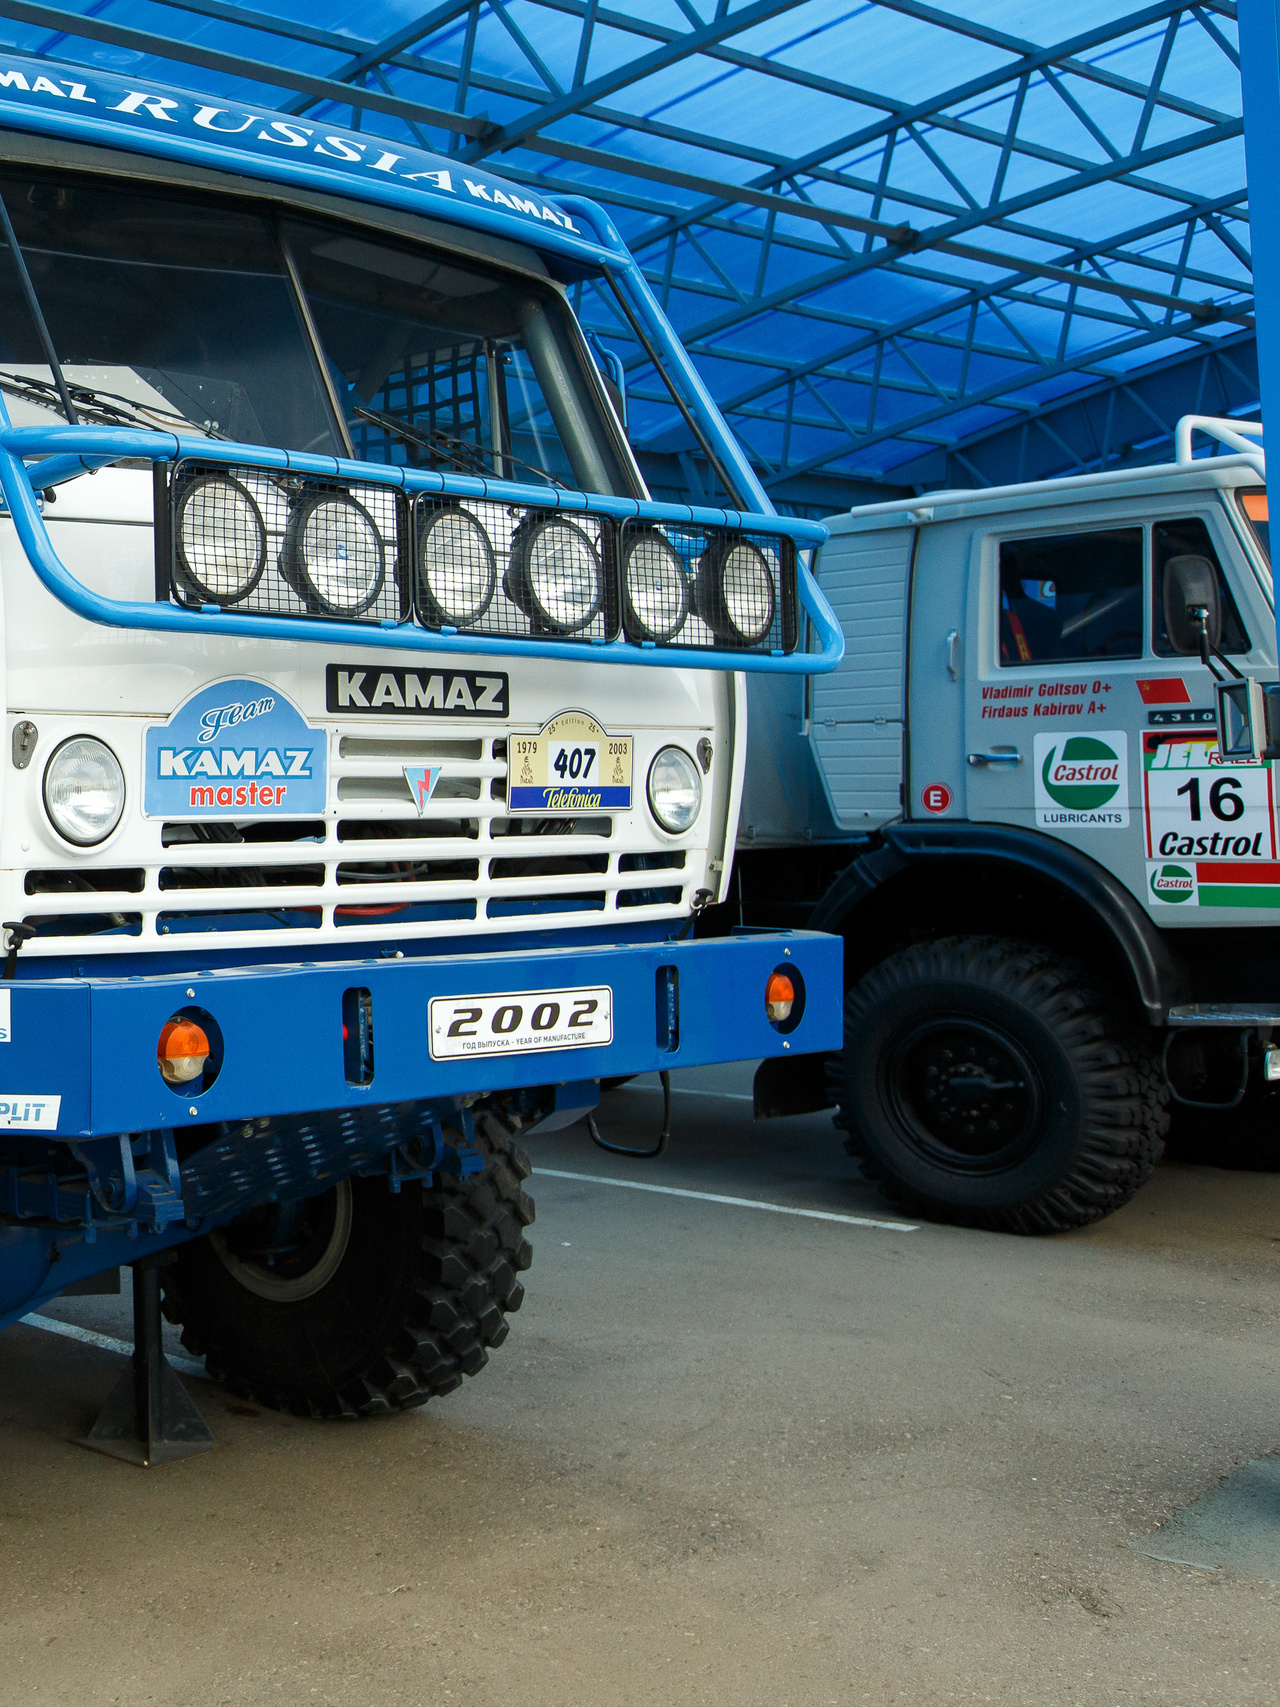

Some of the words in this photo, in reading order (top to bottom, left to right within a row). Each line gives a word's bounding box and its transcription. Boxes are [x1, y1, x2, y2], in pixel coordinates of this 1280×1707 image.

[105, 90, 455, 193] RUSSIA
[463, 179, 580, 234] KAMAZ
[337, 671, 504, 712] KAMAZ
[981, 684, 1034, 700] Vladimir
[1038, 681, 1087, 697] Goltsov
[981, 705, 1028, 719] Firdaus
[1033, 702, 1083, 717] Kabirov
[1088, 701, 1107, 714] A+
[197, 697, 275, 743] Team
[561, 717, 585, 727] Edition
[517, 741, 538, 754] 1979
[608, 743, 628, 755] 2003
[158, 748, 313, 778] KAMAZ
[554, 747, 596, 779] 407
[1053, 763, 1119, 782] Castrol
[190, 781, 287, 806] master
[930, 790, 942, 806] E
[1177, 777, 1245, 822] 16
[1043, 813, 1122, 823] LUBRICANTS
[1158, 832, 1263, 857] Castrol
[1156, 876, 1193, 889] Castrol
[447, 999, 599, 1037] 2002
[462, 1041, 476, 1050] ГОД
[477, 1038, 510, 1049] ВЫПУСКА
[516, 1037, 532, 1046] YEAR
[533, 1036, 542, 1044] OF
[543, 1032, 586, 1043] MANUFACTURE
